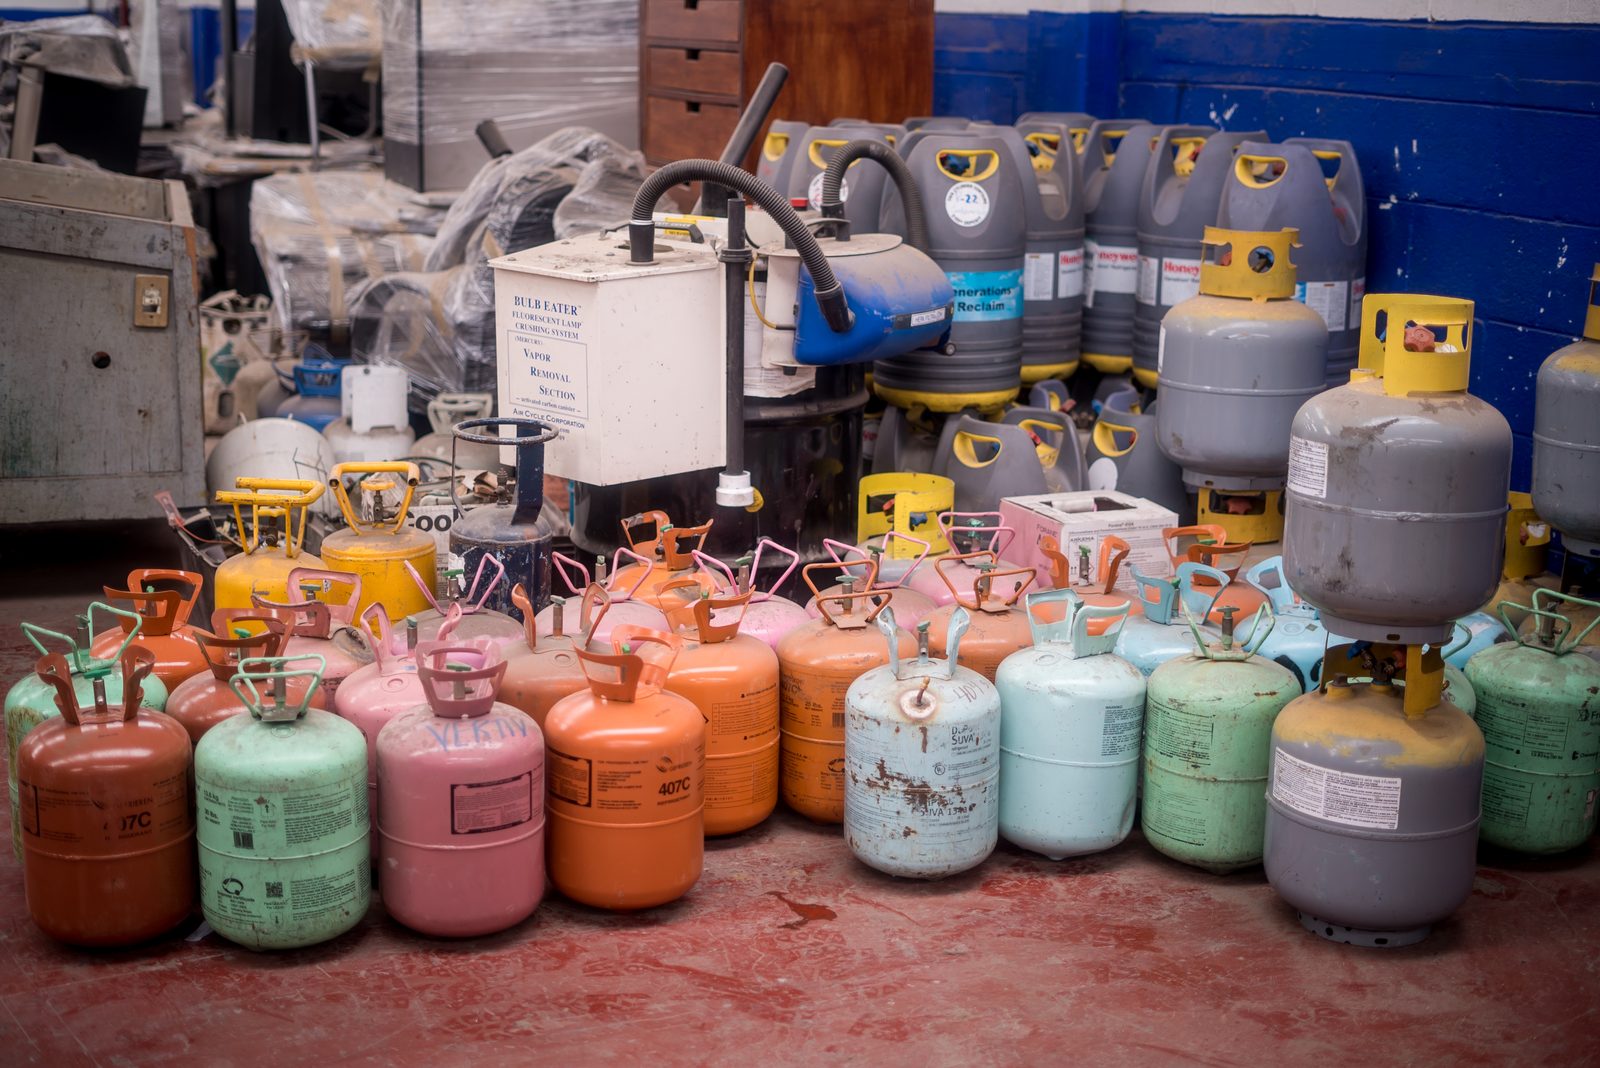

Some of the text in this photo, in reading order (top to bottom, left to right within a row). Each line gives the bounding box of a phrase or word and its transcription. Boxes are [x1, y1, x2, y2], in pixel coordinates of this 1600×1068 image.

[1164, 261, 1200, 277] Honey
[953, 286, 1012, 297] enerations
[514, 295, 578, 316] BULB EATER
[957, 301, 1005, 312] Reclaim
[512, 310, 582, 329] FLUORESCENT LAMP
[515, 322, 579, 340] CRUSHING SYSTEM
[523, 348, 551, 362] VAPOR
[530, 366, 571, 383] REMOVAL
[539, 384, 576, 401] SECTION
[524, 410, 545, 421] CYCLE
[545, 414, 585, 429] CORPORATION
[658, 776, 691, 797] 407C
